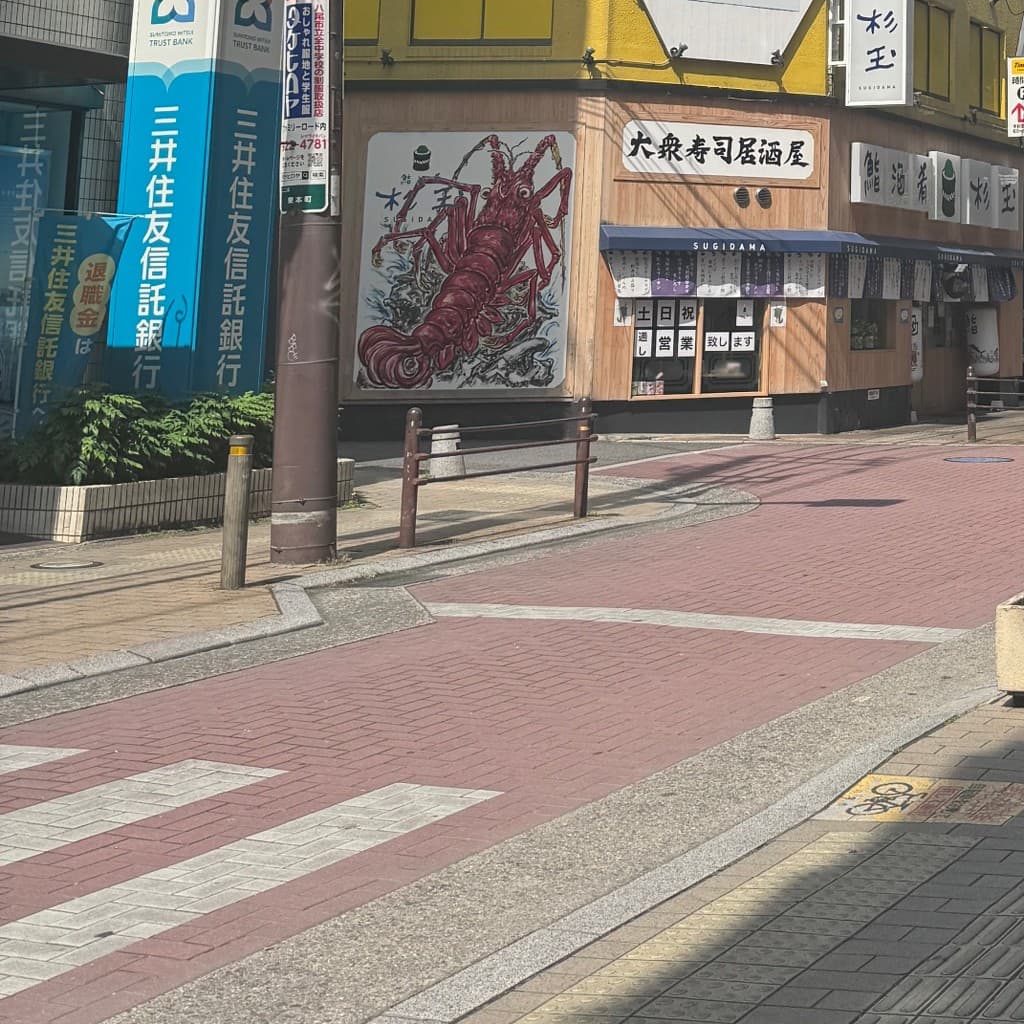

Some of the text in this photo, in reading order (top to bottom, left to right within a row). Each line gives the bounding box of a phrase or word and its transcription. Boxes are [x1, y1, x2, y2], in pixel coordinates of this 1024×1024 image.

[149, 38, 193, 47] TRUST BANK
[233, 40, 271, 54] TRUST BANK
[857, 9, 898, 72] 杉玉
[287, 123, 327, 132] ミリーロード内
[627, 130, 811, 169] 大衆寿司居酒屋
[969, 177, 1016, 214] 杉玉
[131, 105, 181, 391] 三井住友信託銀行
[215, 107, 259, 389] 三井住友信託銀行
[693, 241, 766, 253] SUGIDAMA
[846, 245, 878, 255] SUGIDAMA
[637, 305, 695, 321] 土日祝
[707, 336, 753, 349] 致します
